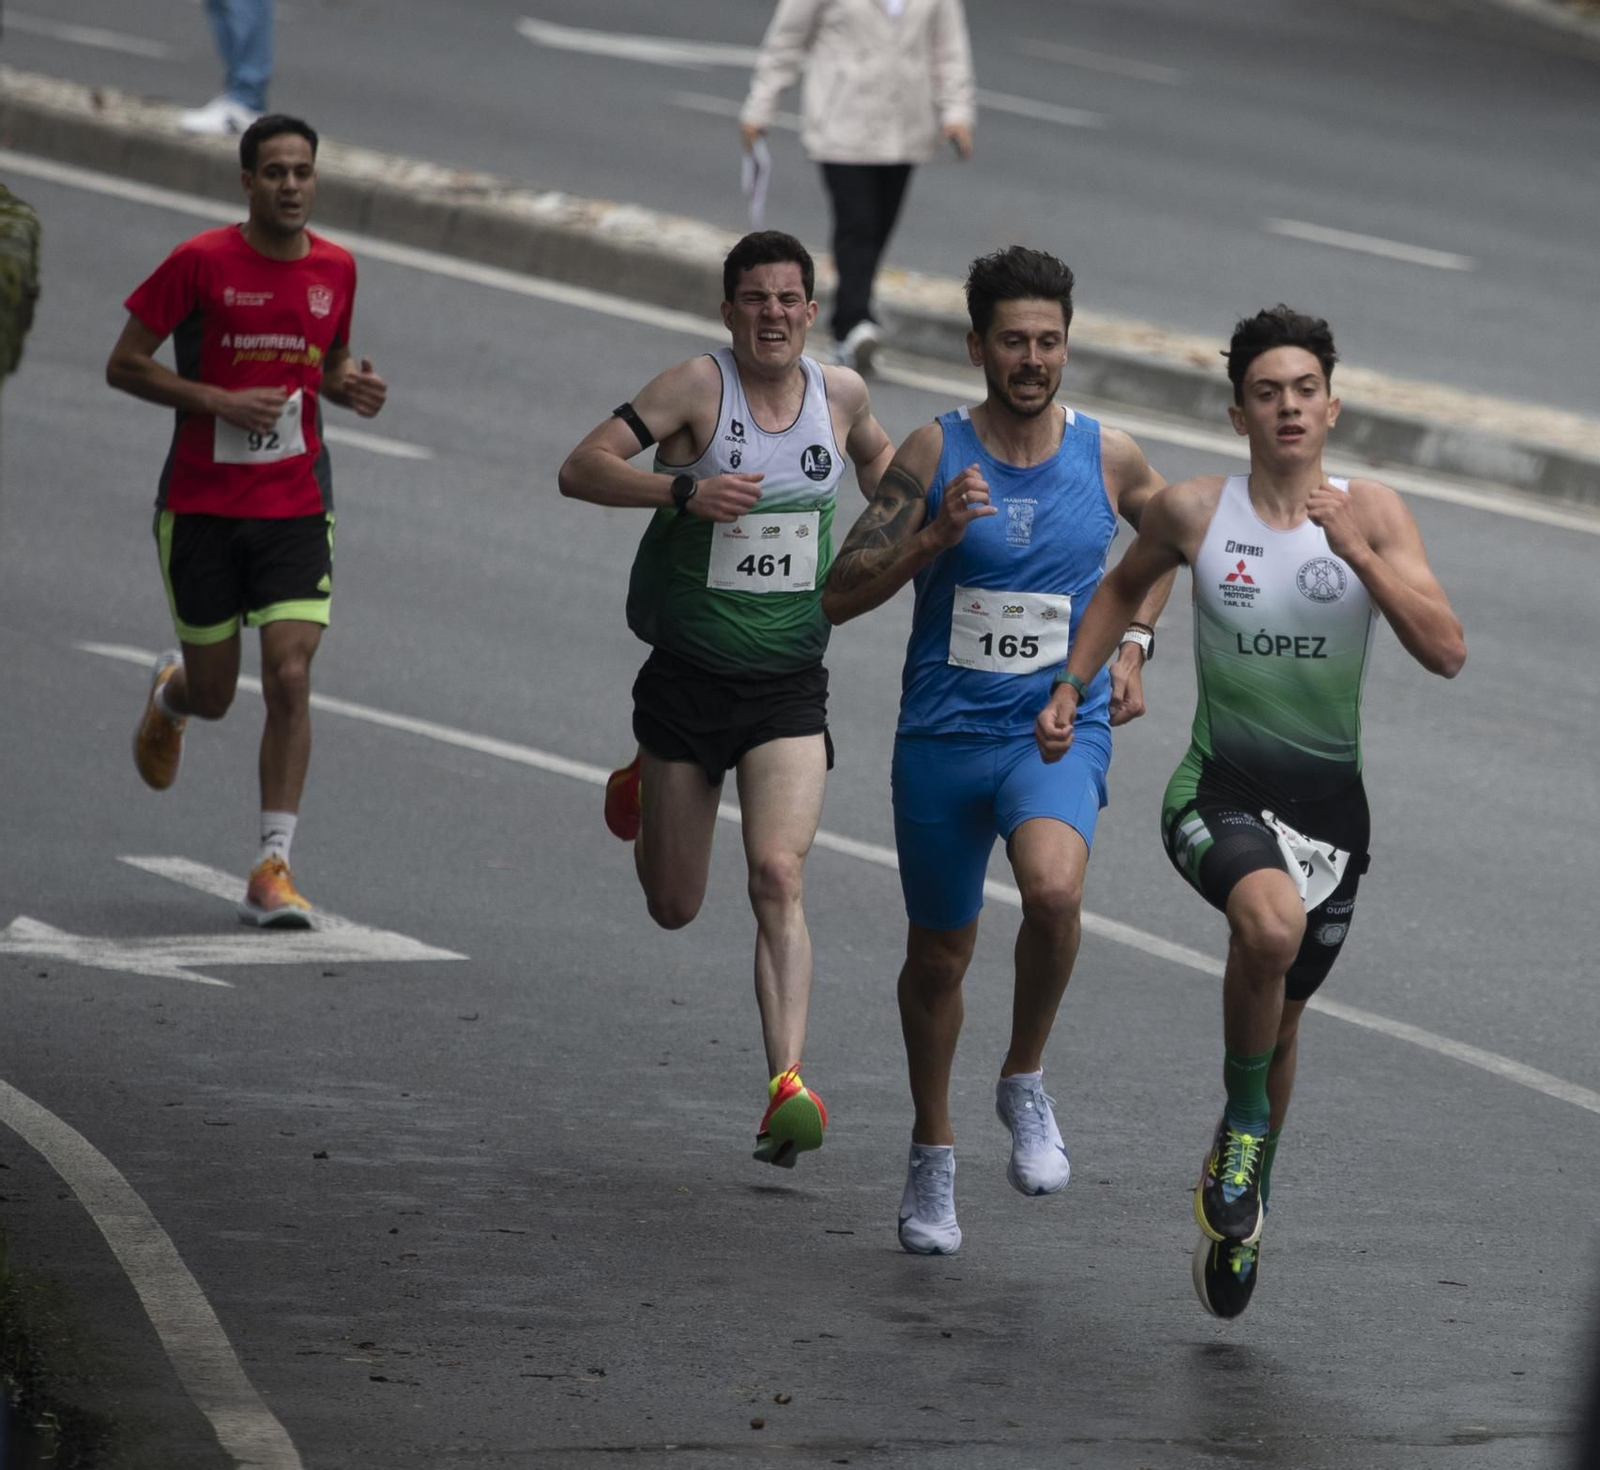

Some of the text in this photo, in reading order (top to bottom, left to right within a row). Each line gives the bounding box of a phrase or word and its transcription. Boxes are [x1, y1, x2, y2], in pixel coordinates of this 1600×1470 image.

[221, 334, 231, 347] A
[248, 431, 280, 452] 92
[736, 553, 792, 577] 461
[1218, 583, 1261, 594] MITSUBISHI
[1223, 591, 1255, 600] MOTORS
[978, 632, 1040, 659] 165
[1236, 628, 1328, 660] LÓPEZ
